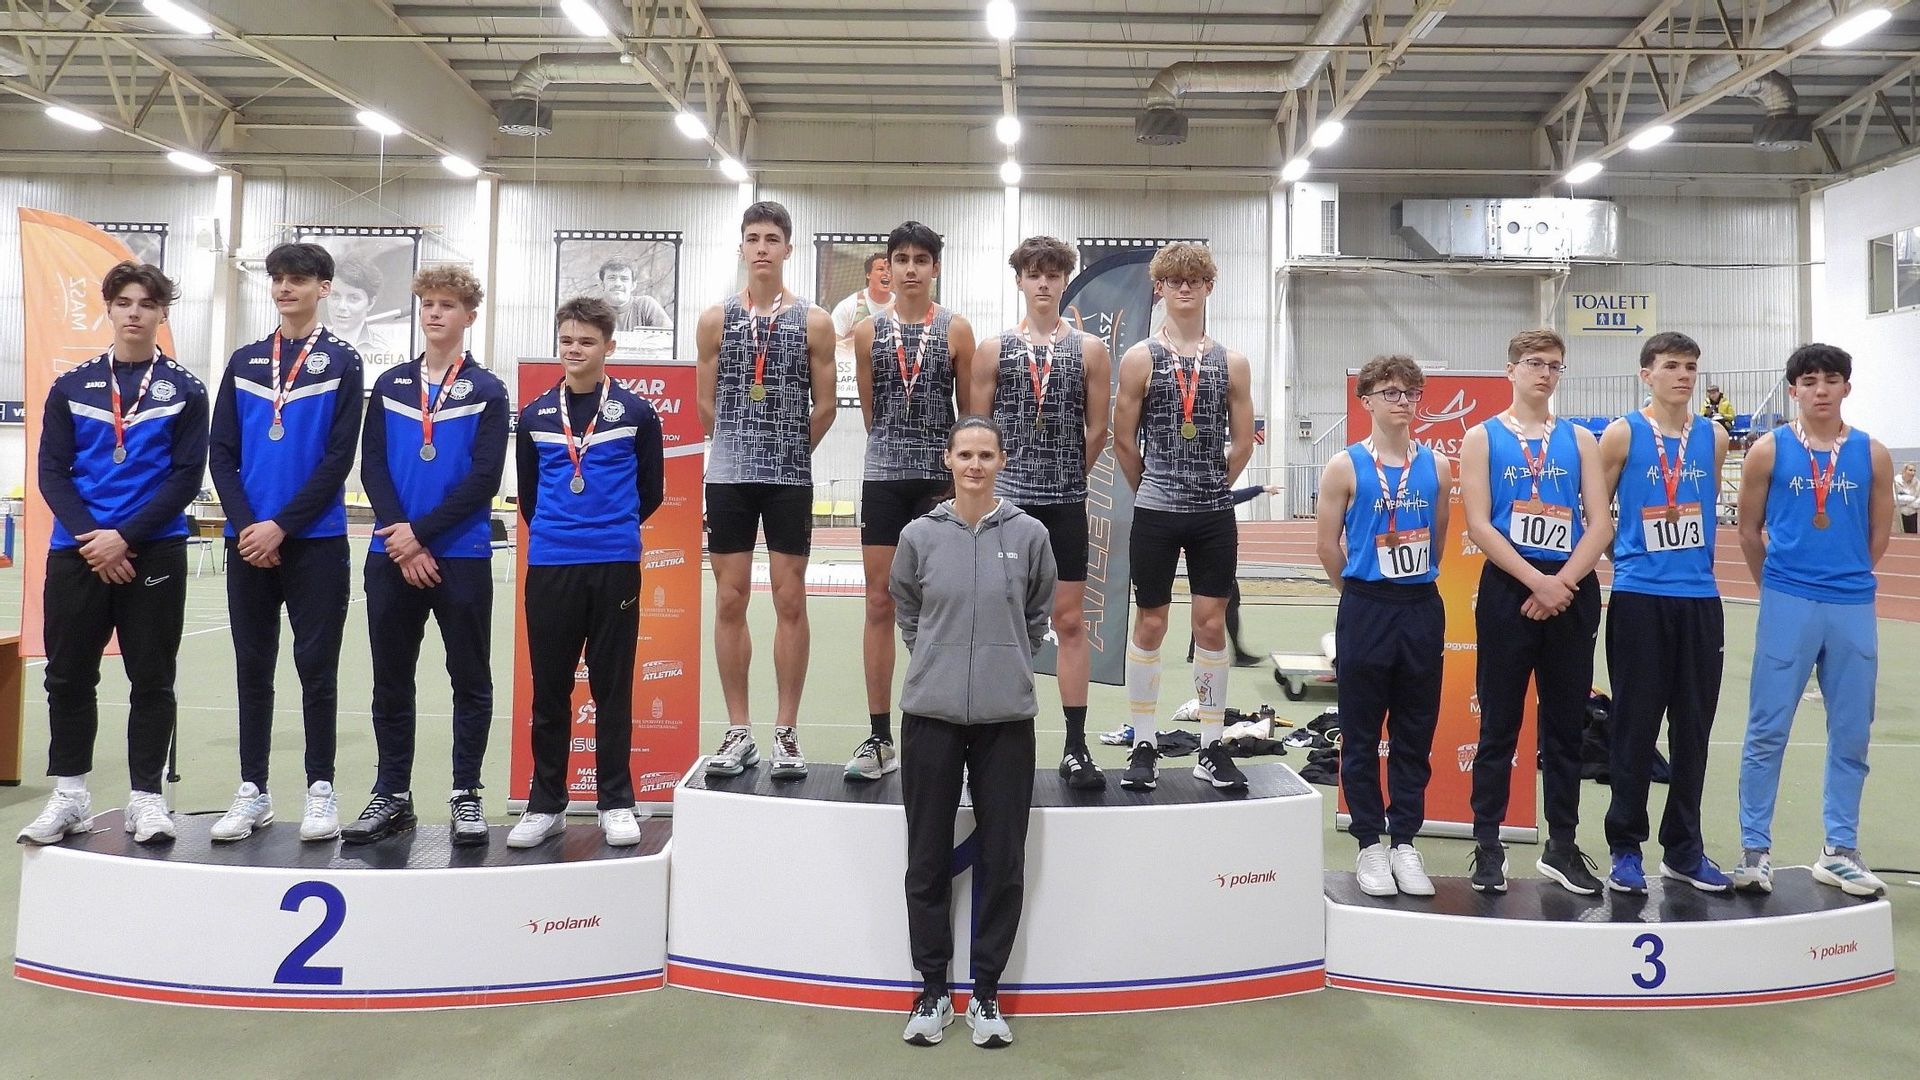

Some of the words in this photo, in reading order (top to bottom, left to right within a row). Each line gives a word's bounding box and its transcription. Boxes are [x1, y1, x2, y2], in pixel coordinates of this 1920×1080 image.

[1572, 294, 1649, 310] TOALETT
[1100, 311, 1114, 352] ASZ
[248, 357, 270, 365] JAKO
[363, 350, 405, 365] NGÉLA
[84, 381, 107, 389] JAKO
[393, 377, 413, 385] JAKO
[537, 407, 558, 416] JAKO
[1521, 515, 1567, 549] 10/2
[1653, 520, 1700, 548] 10/3
[1387, 545, 1428, 575] 10/1
[1229, 869, 1277, 888] polanik
[273, 880, 347, 985] 2
[543, 914, 602, 935] polanik
[1631, 933, 1667, 990] 3
